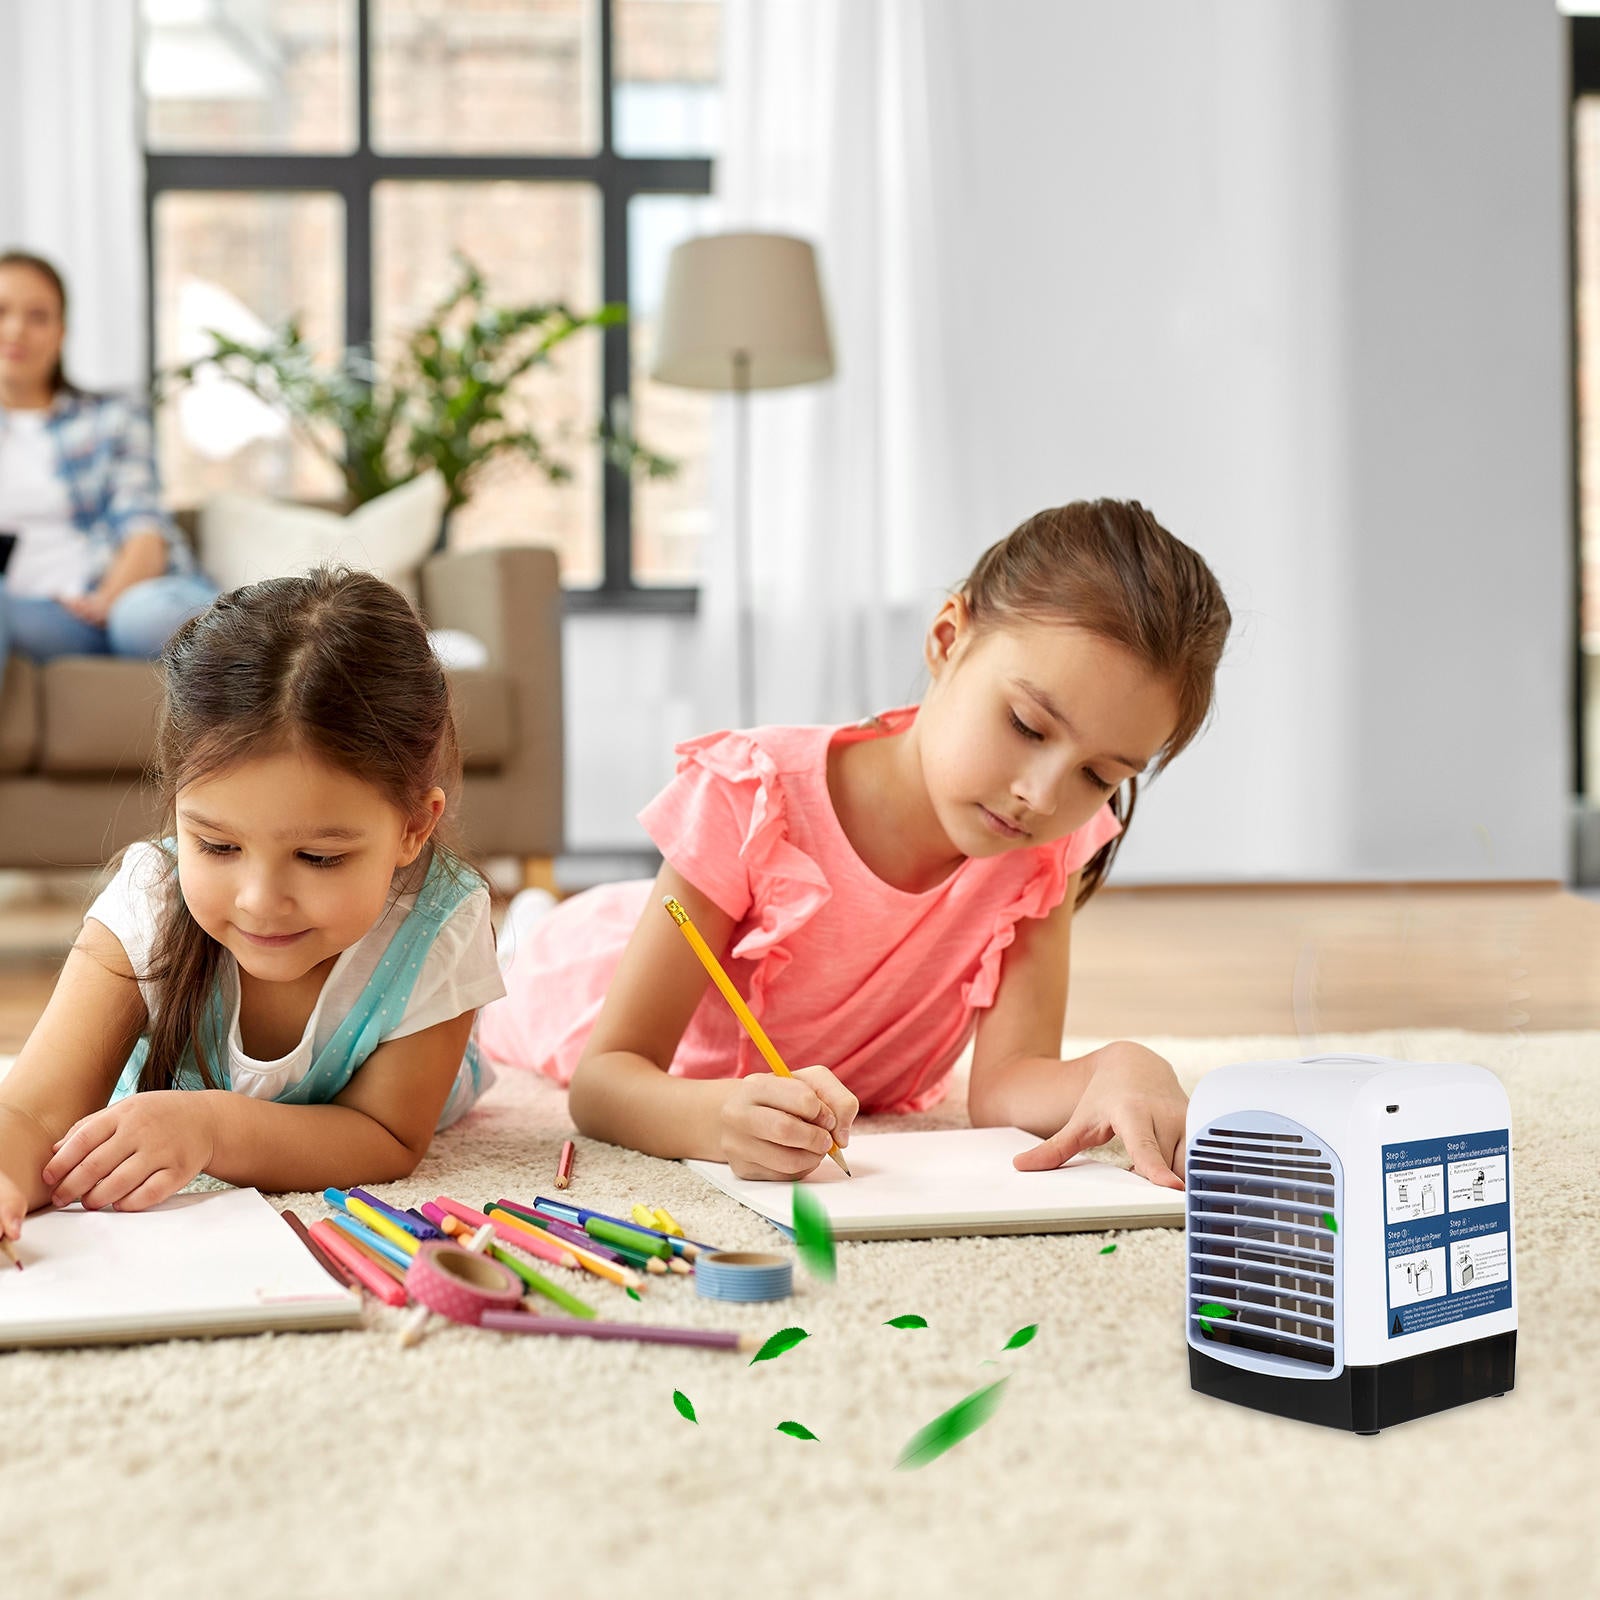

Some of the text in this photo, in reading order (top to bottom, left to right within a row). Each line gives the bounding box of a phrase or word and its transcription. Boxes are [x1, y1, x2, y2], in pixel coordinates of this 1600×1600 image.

[1447, 1143, 1459, 1151] Step
[1386, 1152, 1399, 1160] Step
[1450, 1220, 1461, 1228] Step
[1388, 1231, 1400, 1239] Step
[1430, 1232, 1442, 1240] Power
